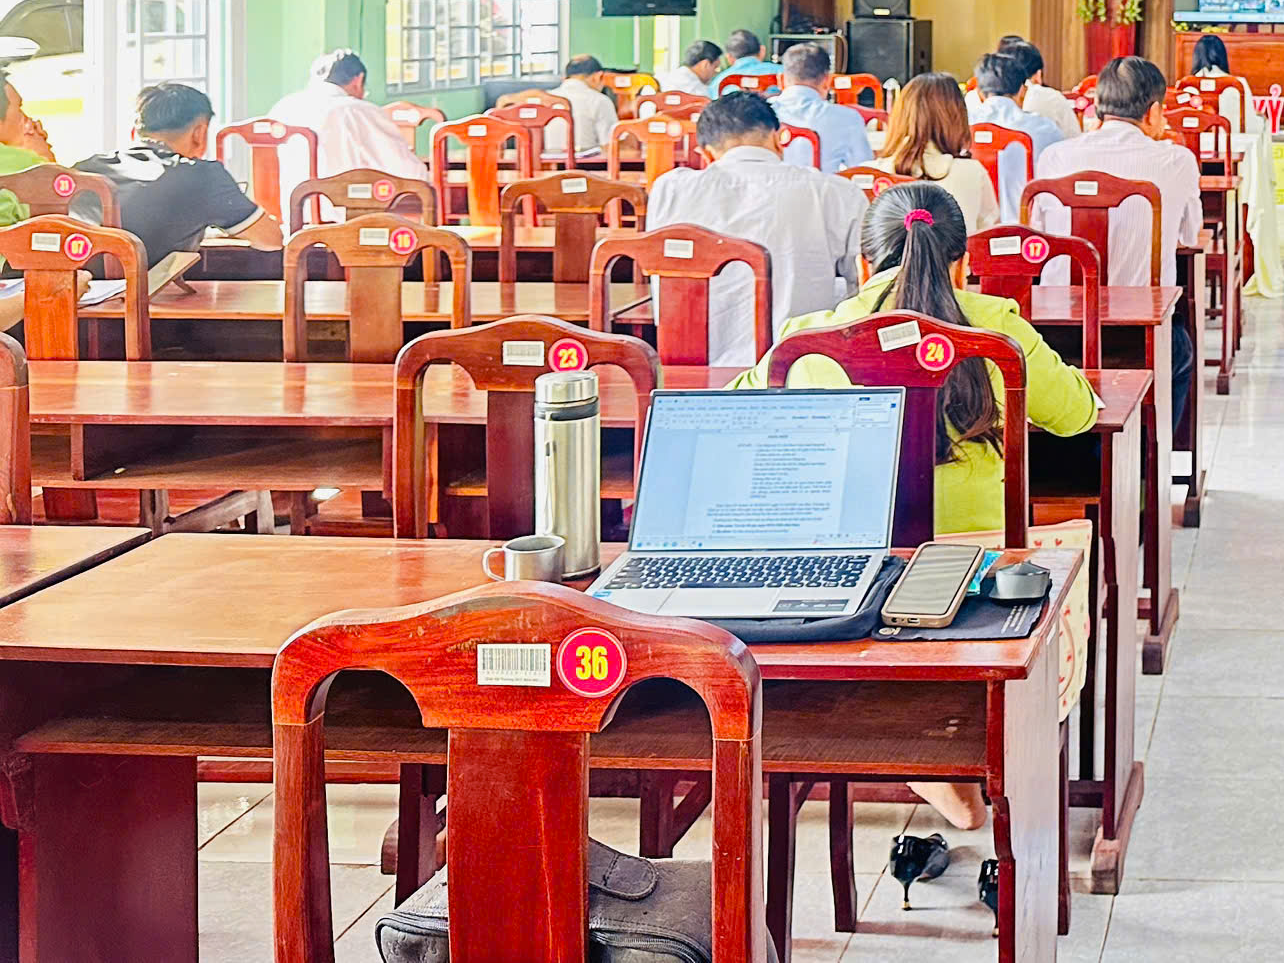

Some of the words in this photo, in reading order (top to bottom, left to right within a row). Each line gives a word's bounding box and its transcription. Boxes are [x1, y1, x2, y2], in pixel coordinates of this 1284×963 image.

[1028, 242, 1043, 257] 17
[558, 347, 578, 368] 23
[925, 342, 945, 363] 24
[575, 644, 609, 681] 36
